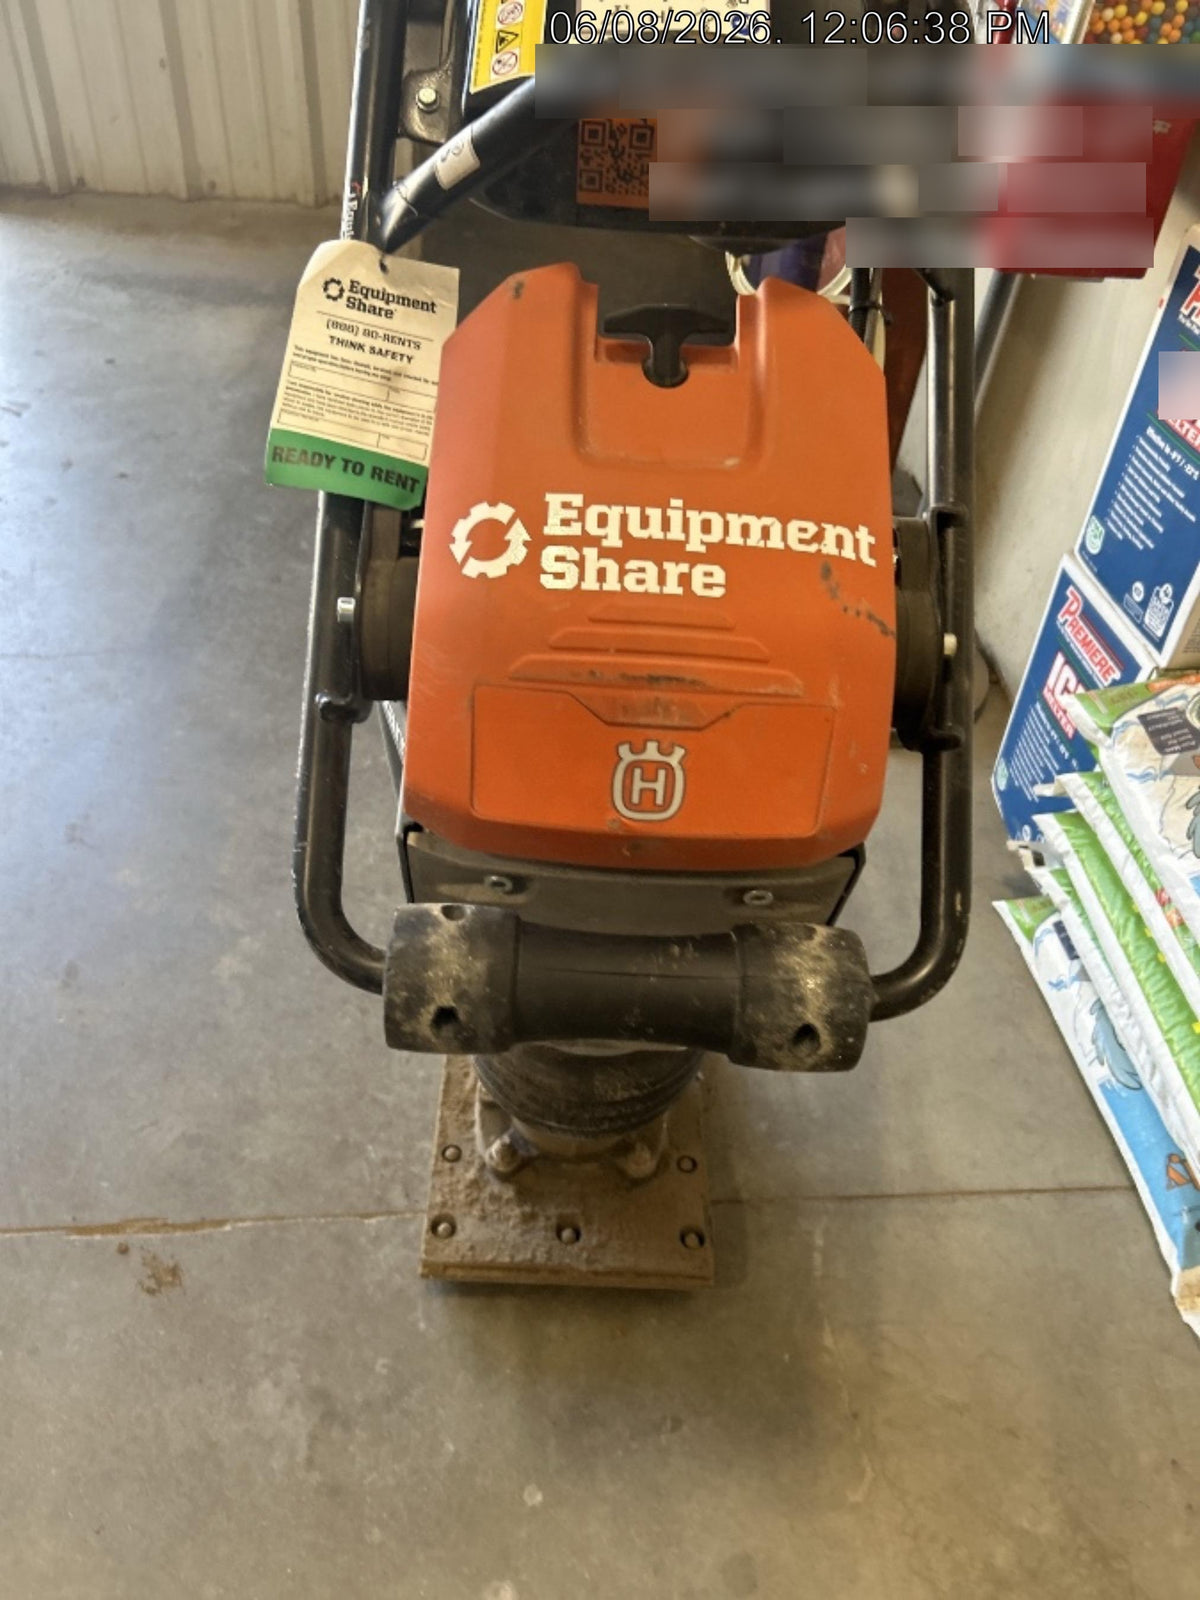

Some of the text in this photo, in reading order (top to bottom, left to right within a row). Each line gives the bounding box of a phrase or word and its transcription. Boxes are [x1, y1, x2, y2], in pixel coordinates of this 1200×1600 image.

[346, 296, 394, 319] Share
[348, 279, 437, 313] Equipment
[329, 335, 413, 364] THINK SAFETY
[272, 446, 420, 493] READY TO RENT
[543, 493, 877, 567] Equipment
[539, 545, 726, 598] Share
[1046, 651, 1086, 700] IC
